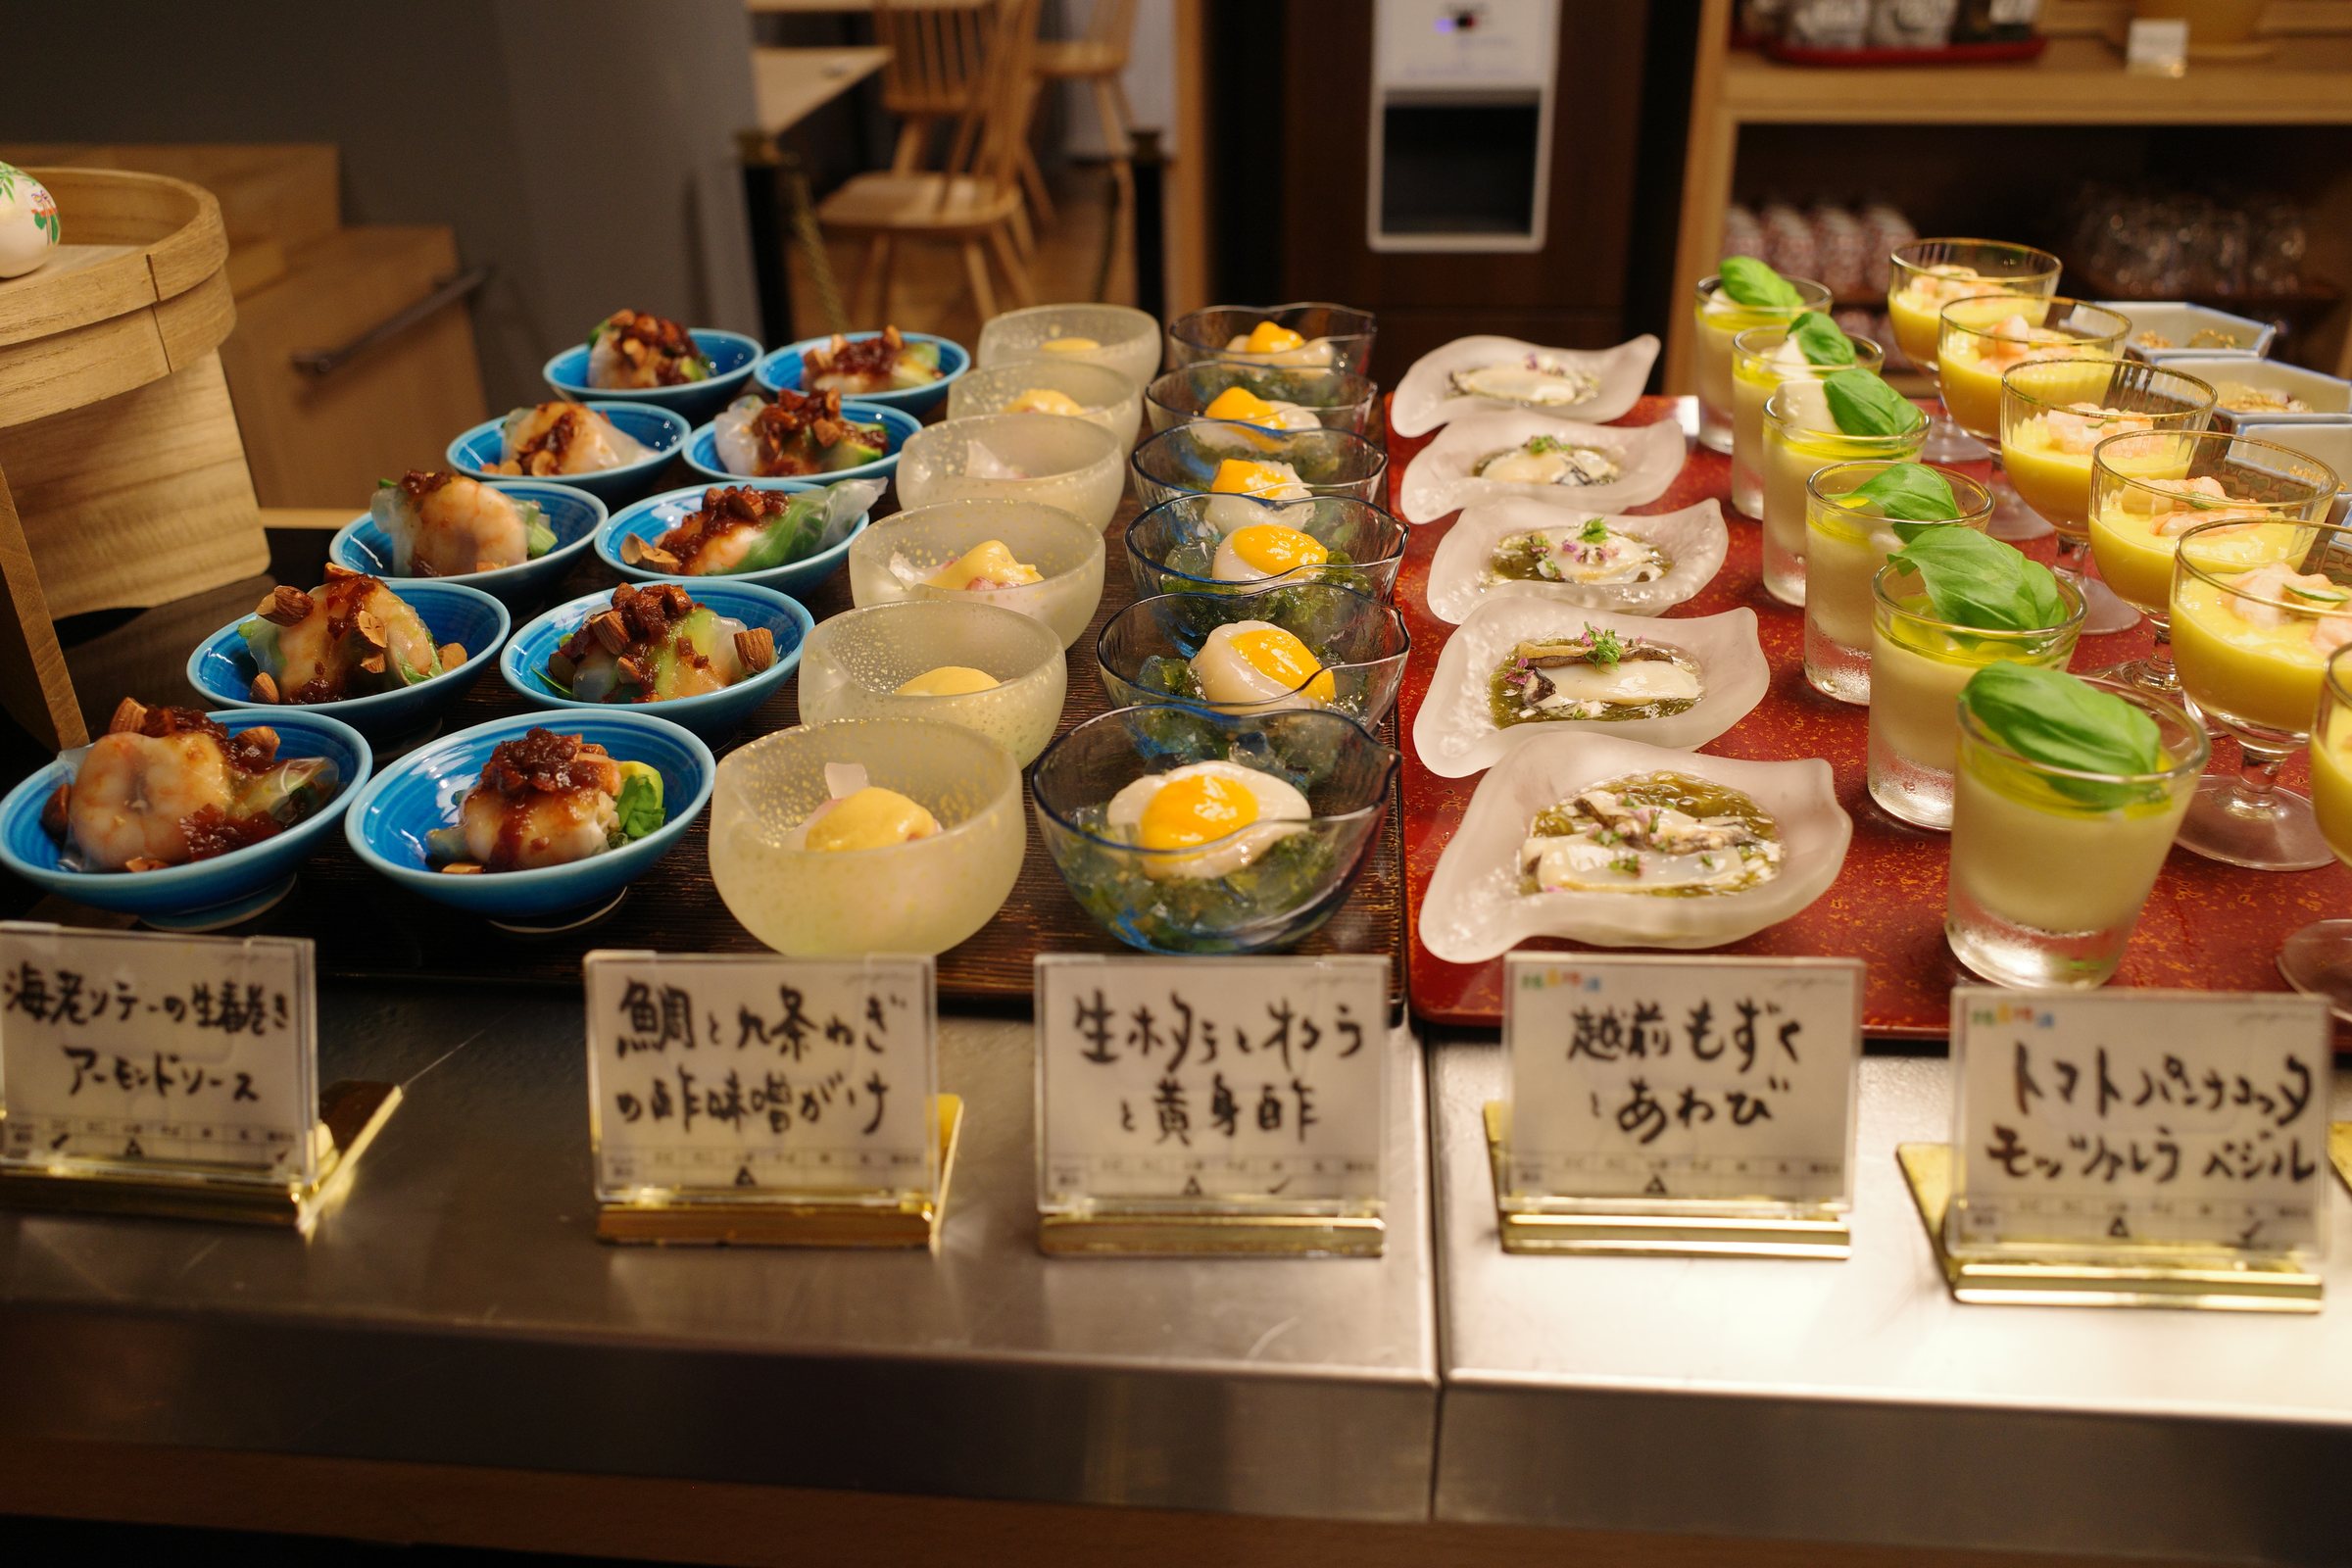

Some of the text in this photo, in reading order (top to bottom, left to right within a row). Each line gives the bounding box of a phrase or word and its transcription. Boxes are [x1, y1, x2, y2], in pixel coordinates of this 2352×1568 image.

[1567, 997, 1802, 1073] 越前もずく
[63, 1047, 260, 1102] アーモンドソース
